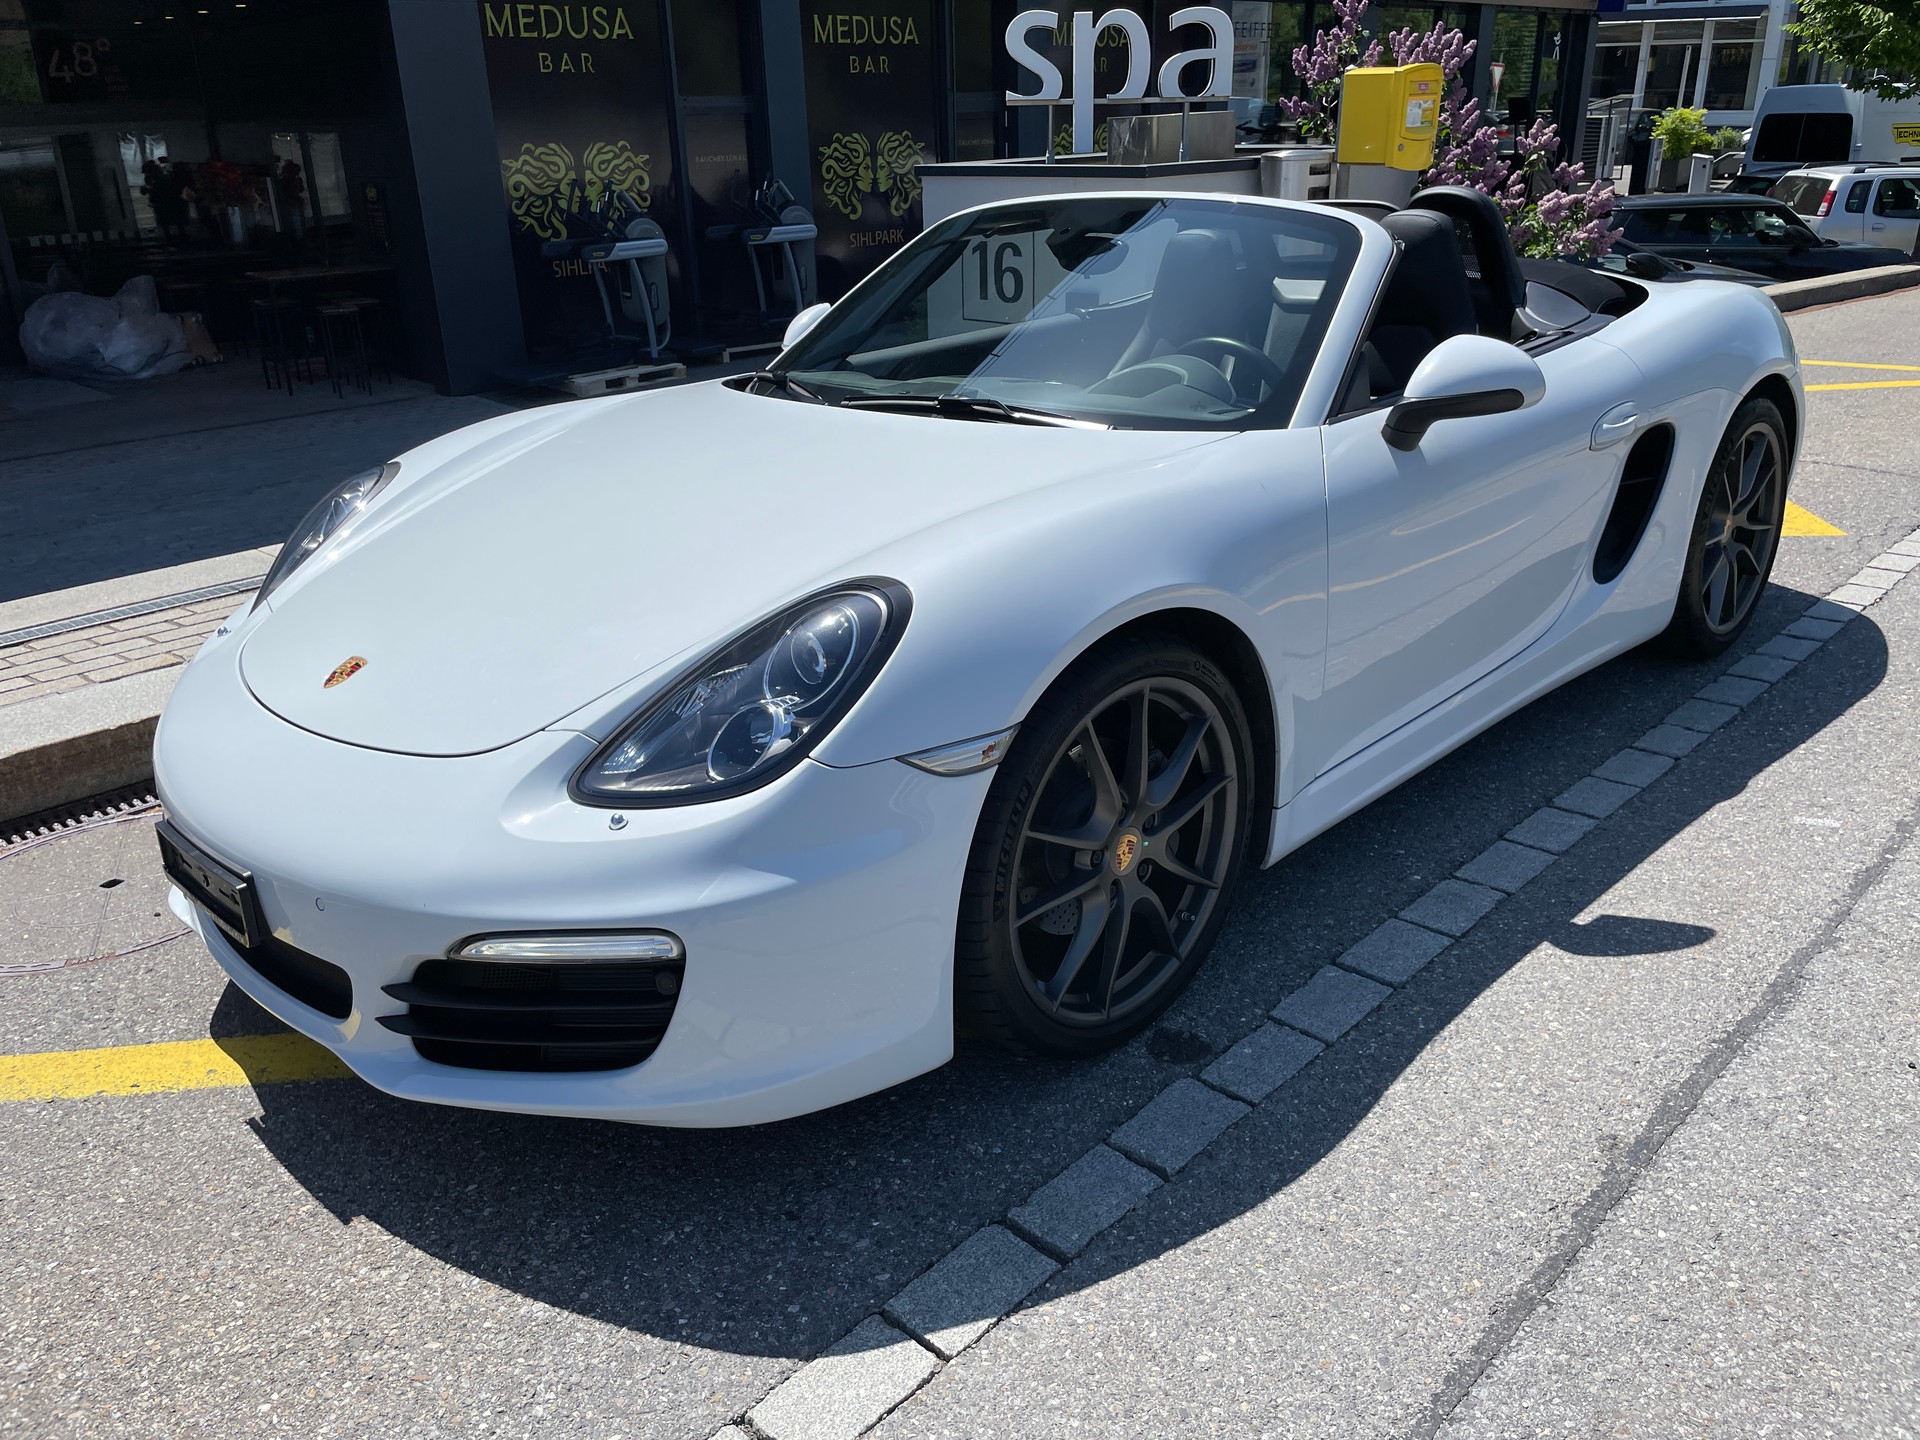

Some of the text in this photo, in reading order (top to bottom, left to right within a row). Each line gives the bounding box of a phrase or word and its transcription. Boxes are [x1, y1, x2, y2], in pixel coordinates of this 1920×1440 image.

[484, 3, 634, 39] MEDUSA
[813, 14, 920, 45] MEDUSA
[1052, 22, 1128, 47] MUSA
[538, 52, 595, 73] BAR
[849, 55, 890, 73] BAR
[1005, 6, 1234, 153] spa
[1893, 126, 1920, 139] TECHN
[849, 228, 905, 248] SIHLPARK
[972, 240, 1024, 304] 16
[994, 784, 1031, 894] MICHELIN
